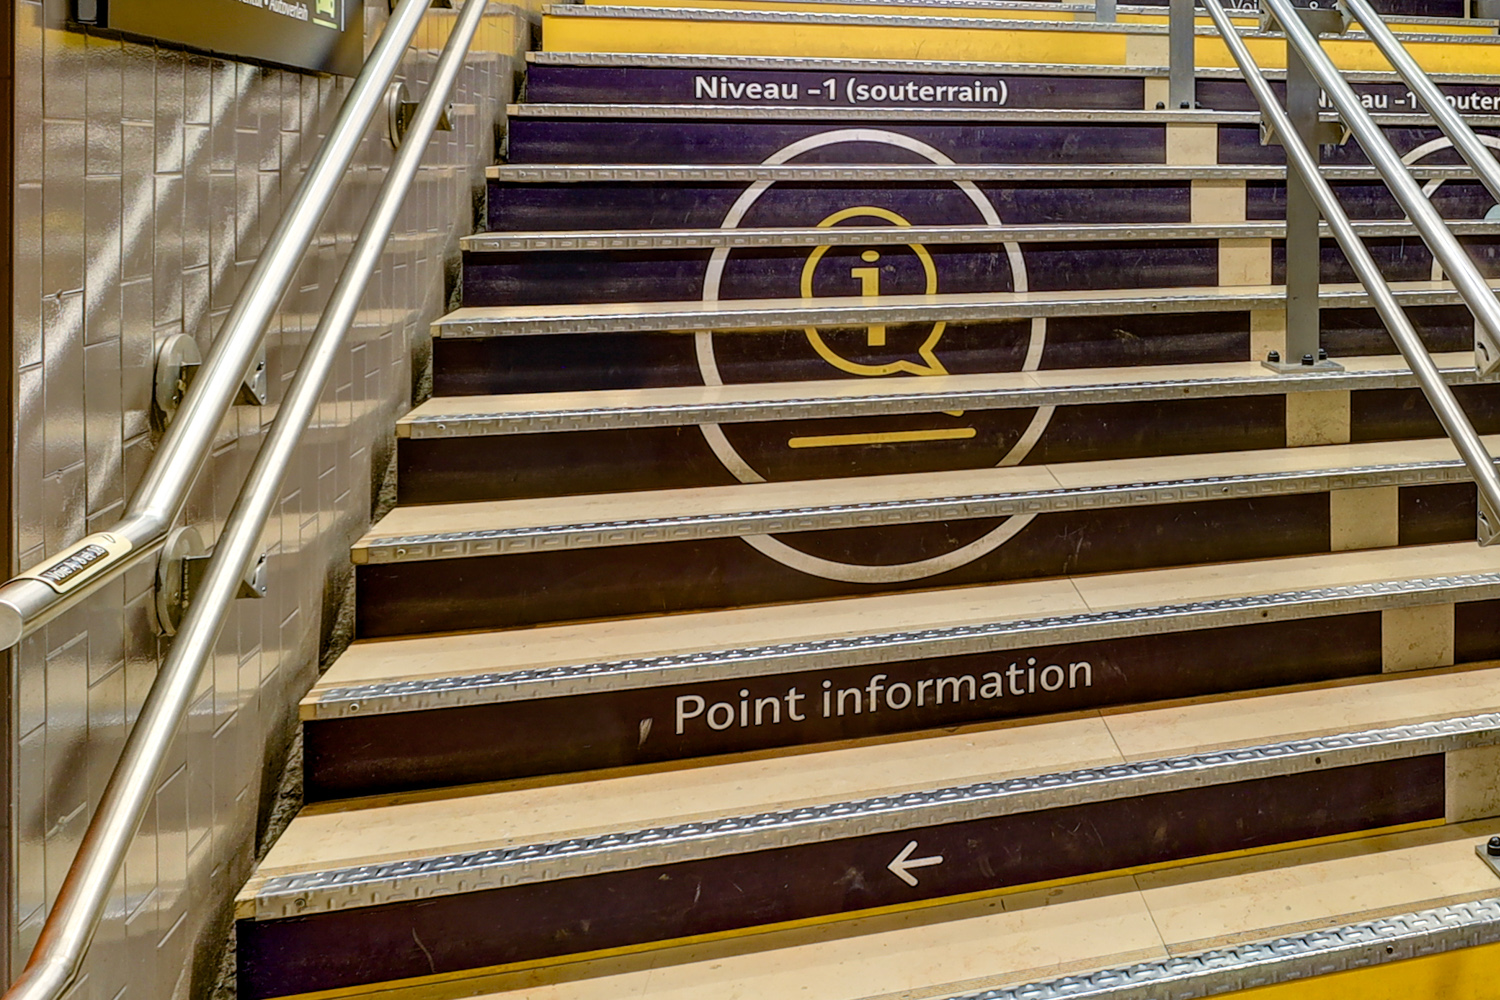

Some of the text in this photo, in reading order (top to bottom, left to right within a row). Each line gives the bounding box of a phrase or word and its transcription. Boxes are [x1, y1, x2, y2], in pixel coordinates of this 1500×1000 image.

[695, 76, 1009, 105] Niveau -1 (souterrain)
[1395, 90, 1417, 109] -1
[675, 656, 1092, 735] Point information
